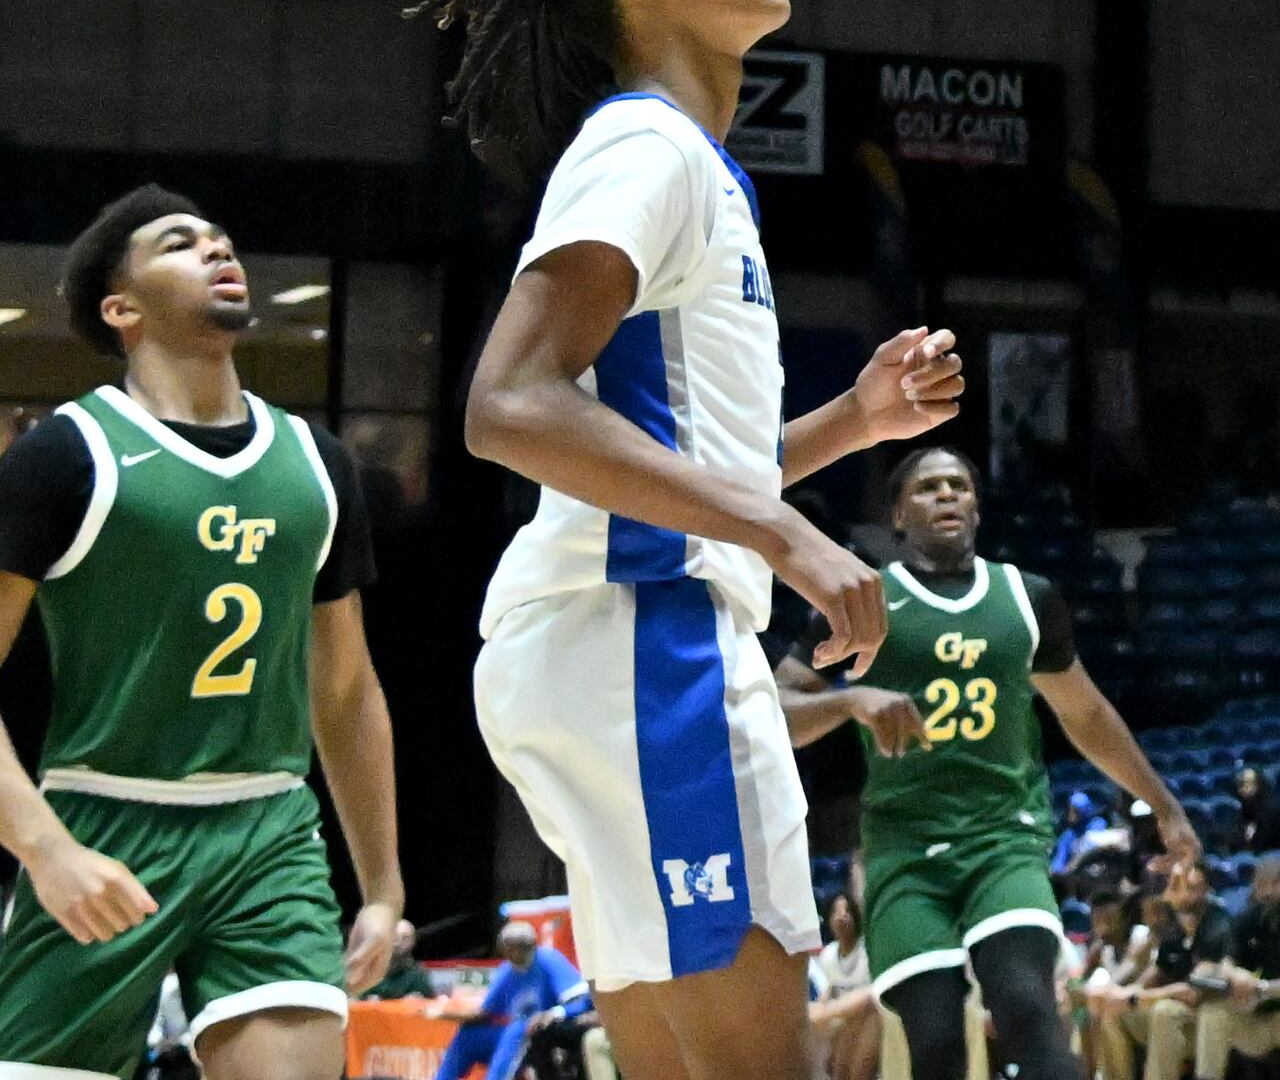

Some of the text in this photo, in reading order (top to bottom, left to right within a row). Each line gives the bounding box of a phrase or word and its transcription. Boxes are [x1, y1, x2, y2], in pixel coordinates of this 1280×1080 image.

[880, 64, 1023, 108] MACON
[895, 110, 952, 139] GOLF
[197, 505, 276, 564] GF
[191, 582, 262, 697] 2
[935, 632, 988, 669] GF
[924, 678, 997, 741] 23
[663, 853, 734, 907] M
